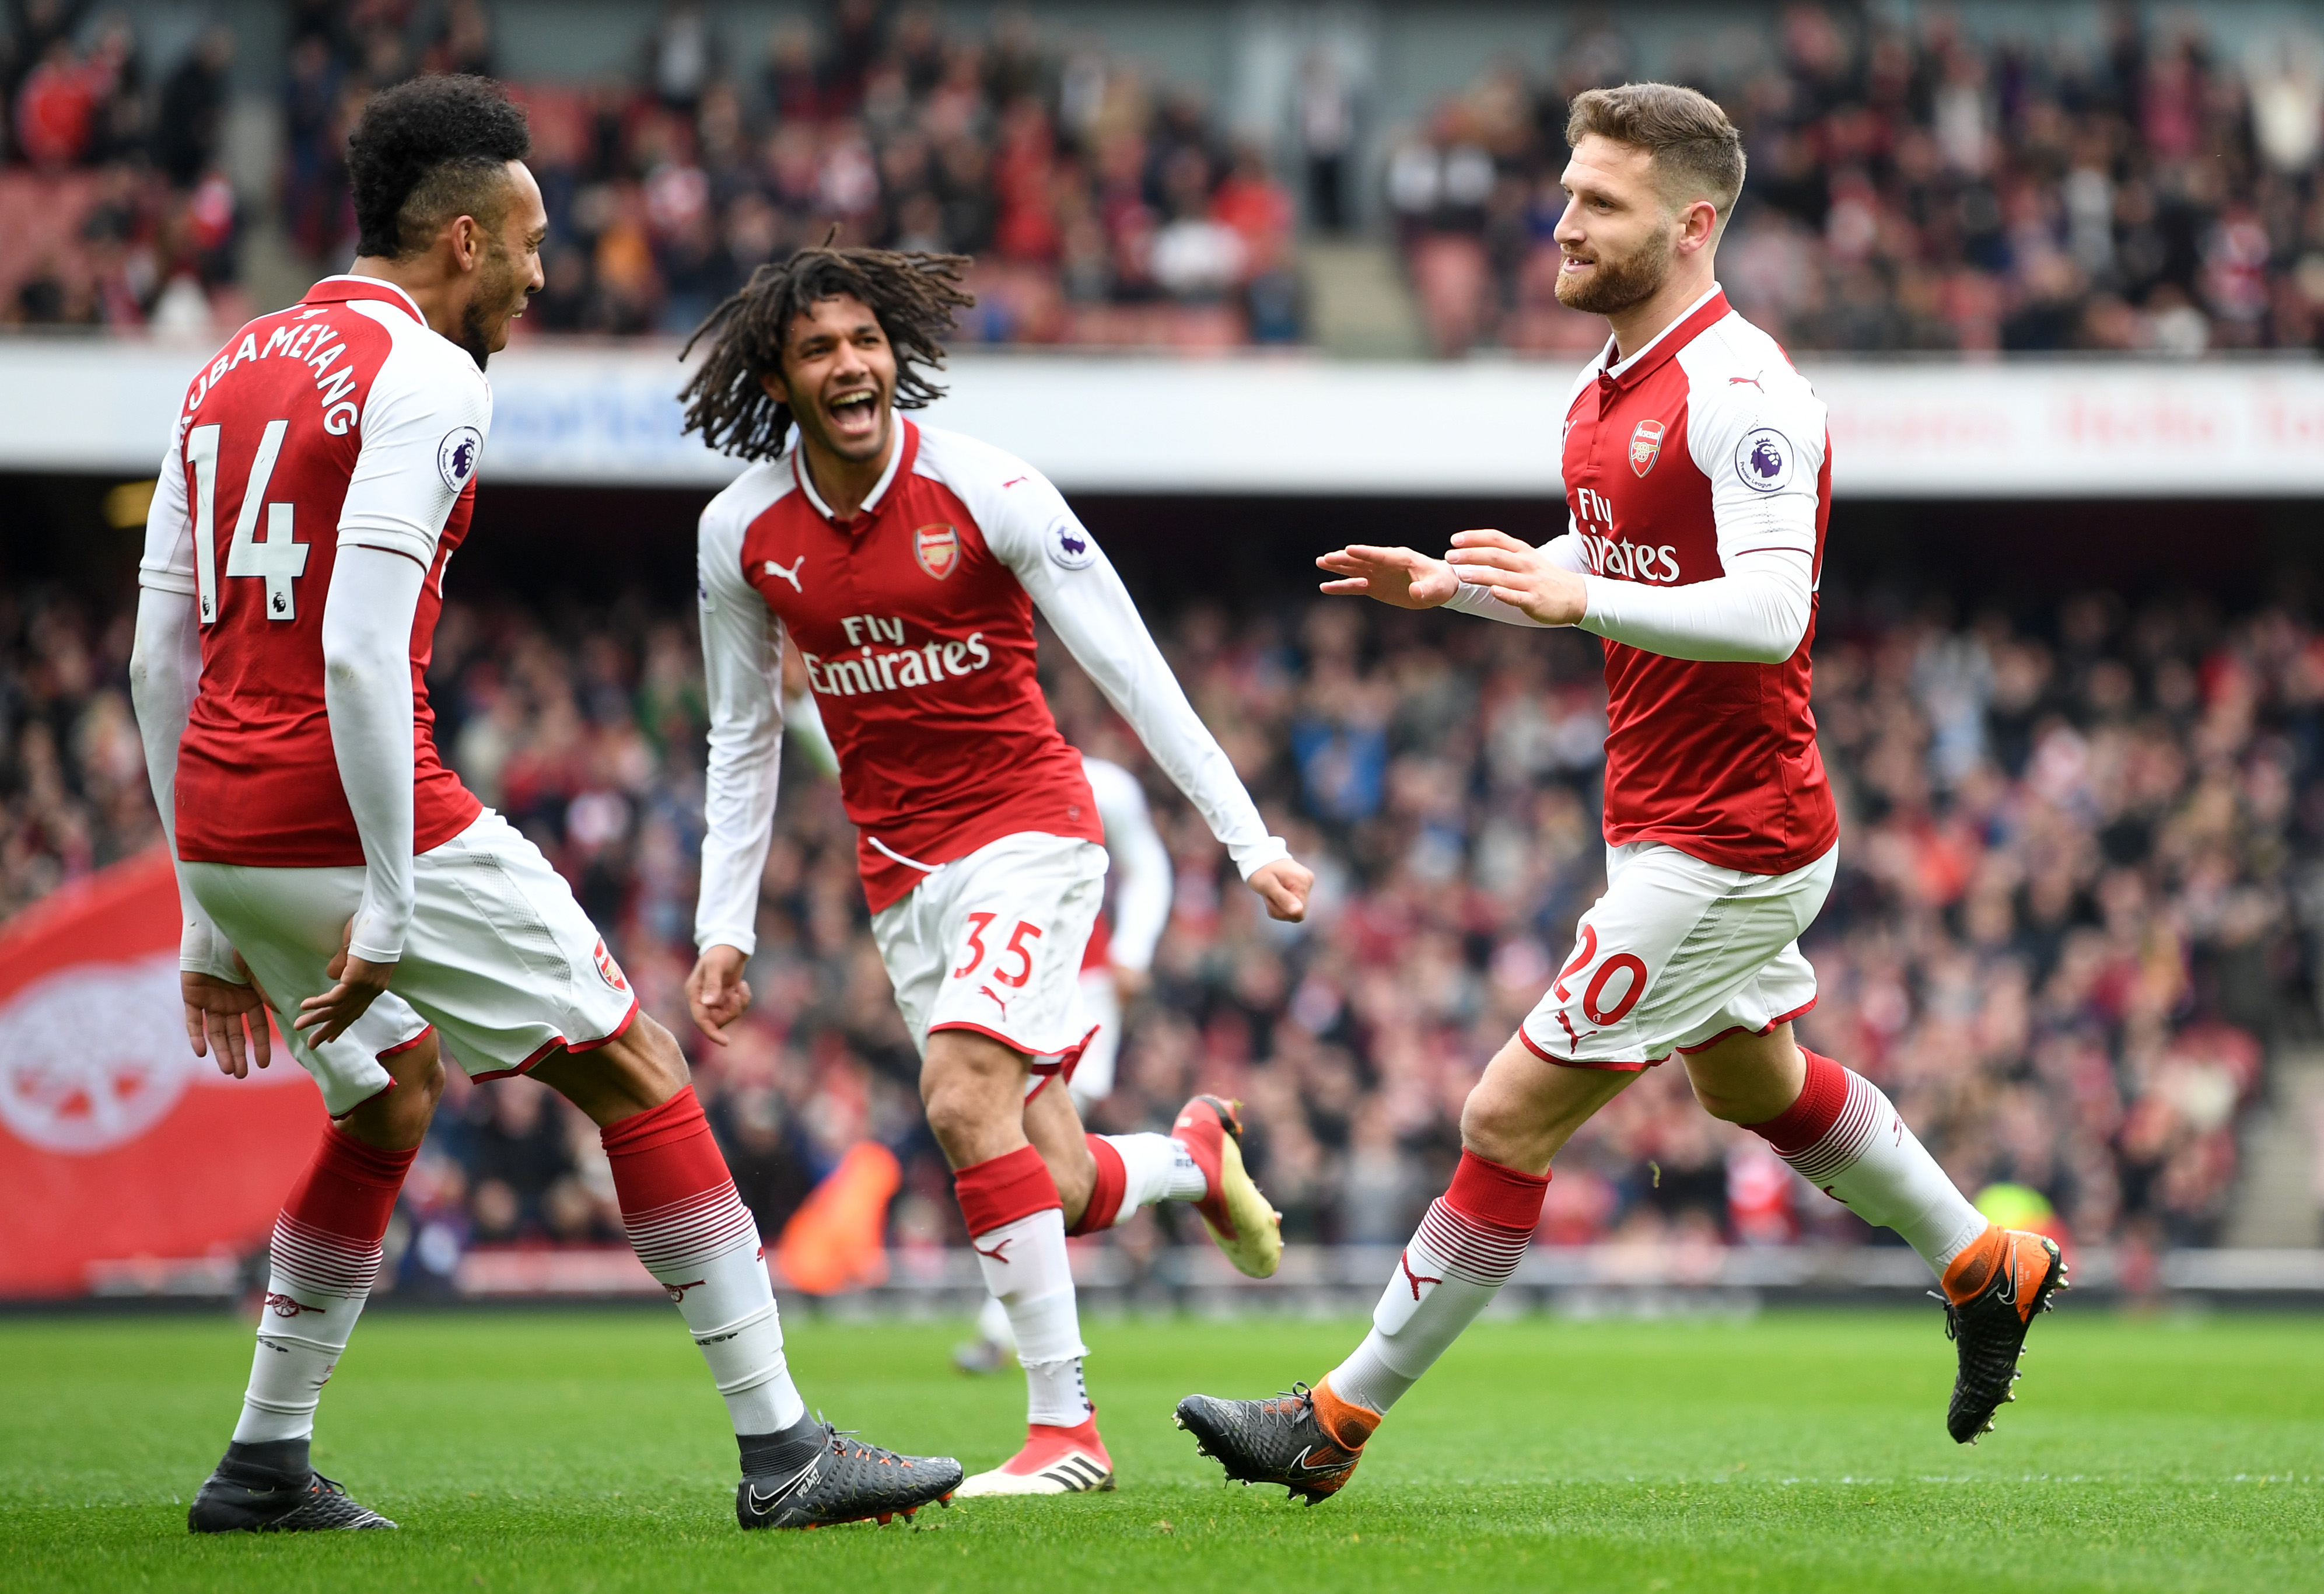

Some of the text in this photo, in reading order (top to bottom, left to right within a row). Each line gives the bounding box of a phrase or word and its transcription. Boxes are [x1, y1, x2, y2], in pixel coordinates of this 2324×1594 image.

[180, 324, 358, 446] UBAMEYANG
[1577, 488, 1613, 530] Fly
[1740, 461, 1772, 488] Premier League
[187, 420, 310, 624] 14
[803, 632, 991, 696] Emirates
[841, 614, 905, 646] Fly
[954, 912, 1042, 988] 35
[1553, 924, 1648, 1026] 20
